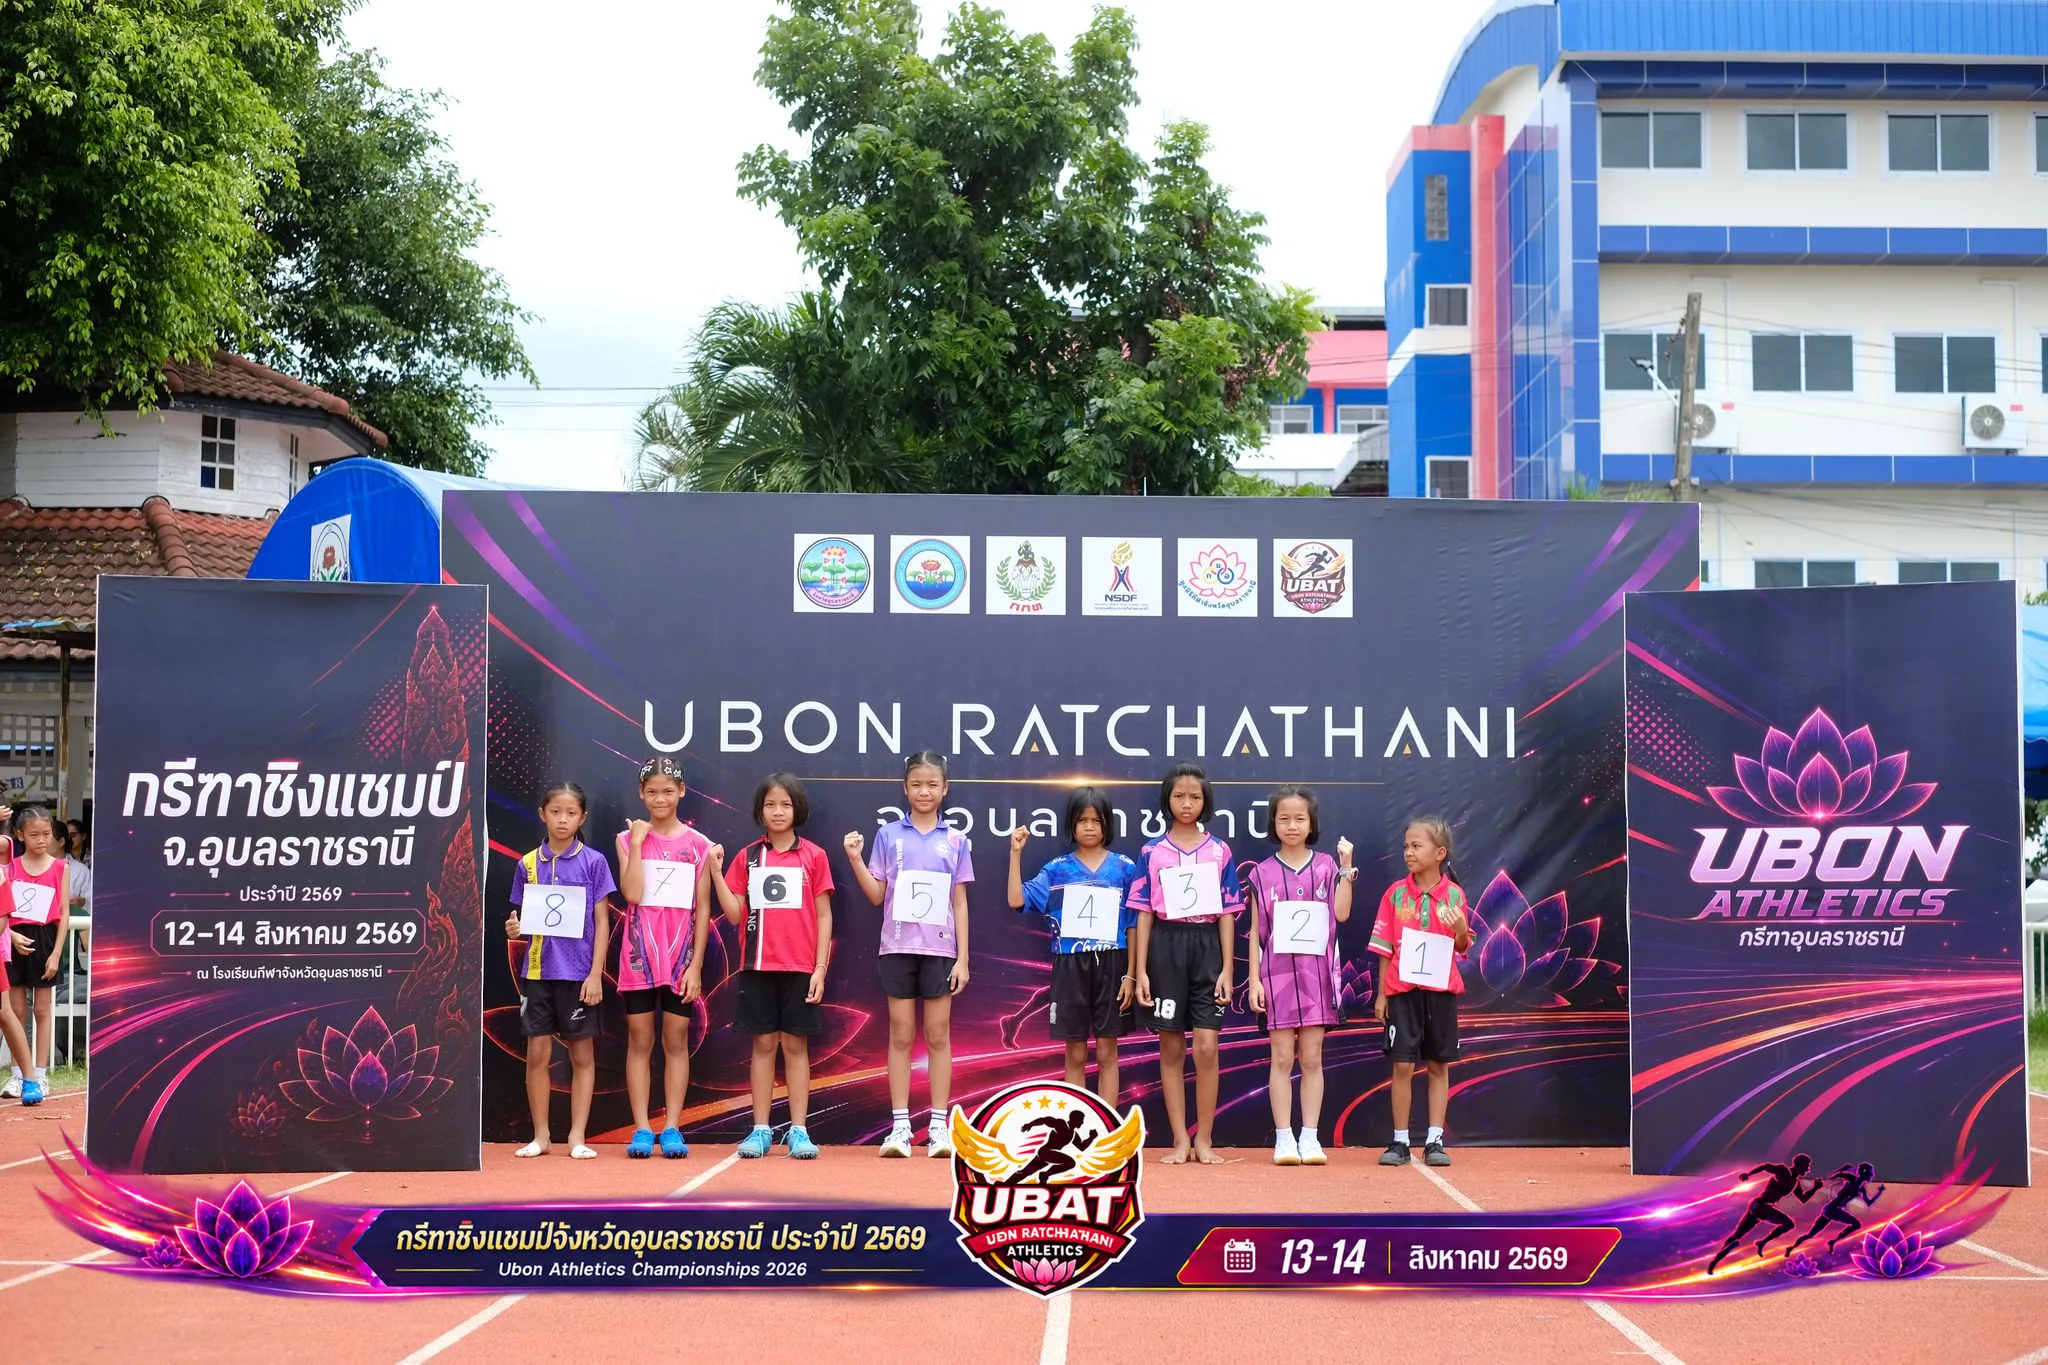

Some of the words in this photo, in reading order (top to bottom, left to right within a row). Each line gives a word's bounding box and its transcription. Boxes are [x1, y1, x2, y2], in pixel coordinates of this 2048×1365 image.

[1104, 594, 1138, 602] NSDF
[1286, 578, 1340, 592] UBAT
[645, 700, 900, 754] UBON
[952, 702, 1515, 758] RATCHATHANI
[163, 825, 416, 879] จ.อุบลราชธานี
[1689, 825, 1970, 883] UBON
[239, 884, 297, 902] ประจำปี
[301, 886, 343, 902] 2569
[653, 867, 676, 897] 7
[762, 874, 787, 902] 6
[1178, 872, 1198, 911] 3
[544, 893, 566, 928] 8
[911, 881, 934, 919] 5
[1077, 894, 1098, 929] 4
[1704, 888, 1957, 917] ATHLETICS
[254, 920, 347, 946] สิงหาคม
[355, 922, 417, 945] 2569
[1289, 909, 1316, 943] 2
[196, 969, 209, 979] ณ
[1411, 941, 1432, 976] 1
[1154, 997, 1177, 1019] 18
